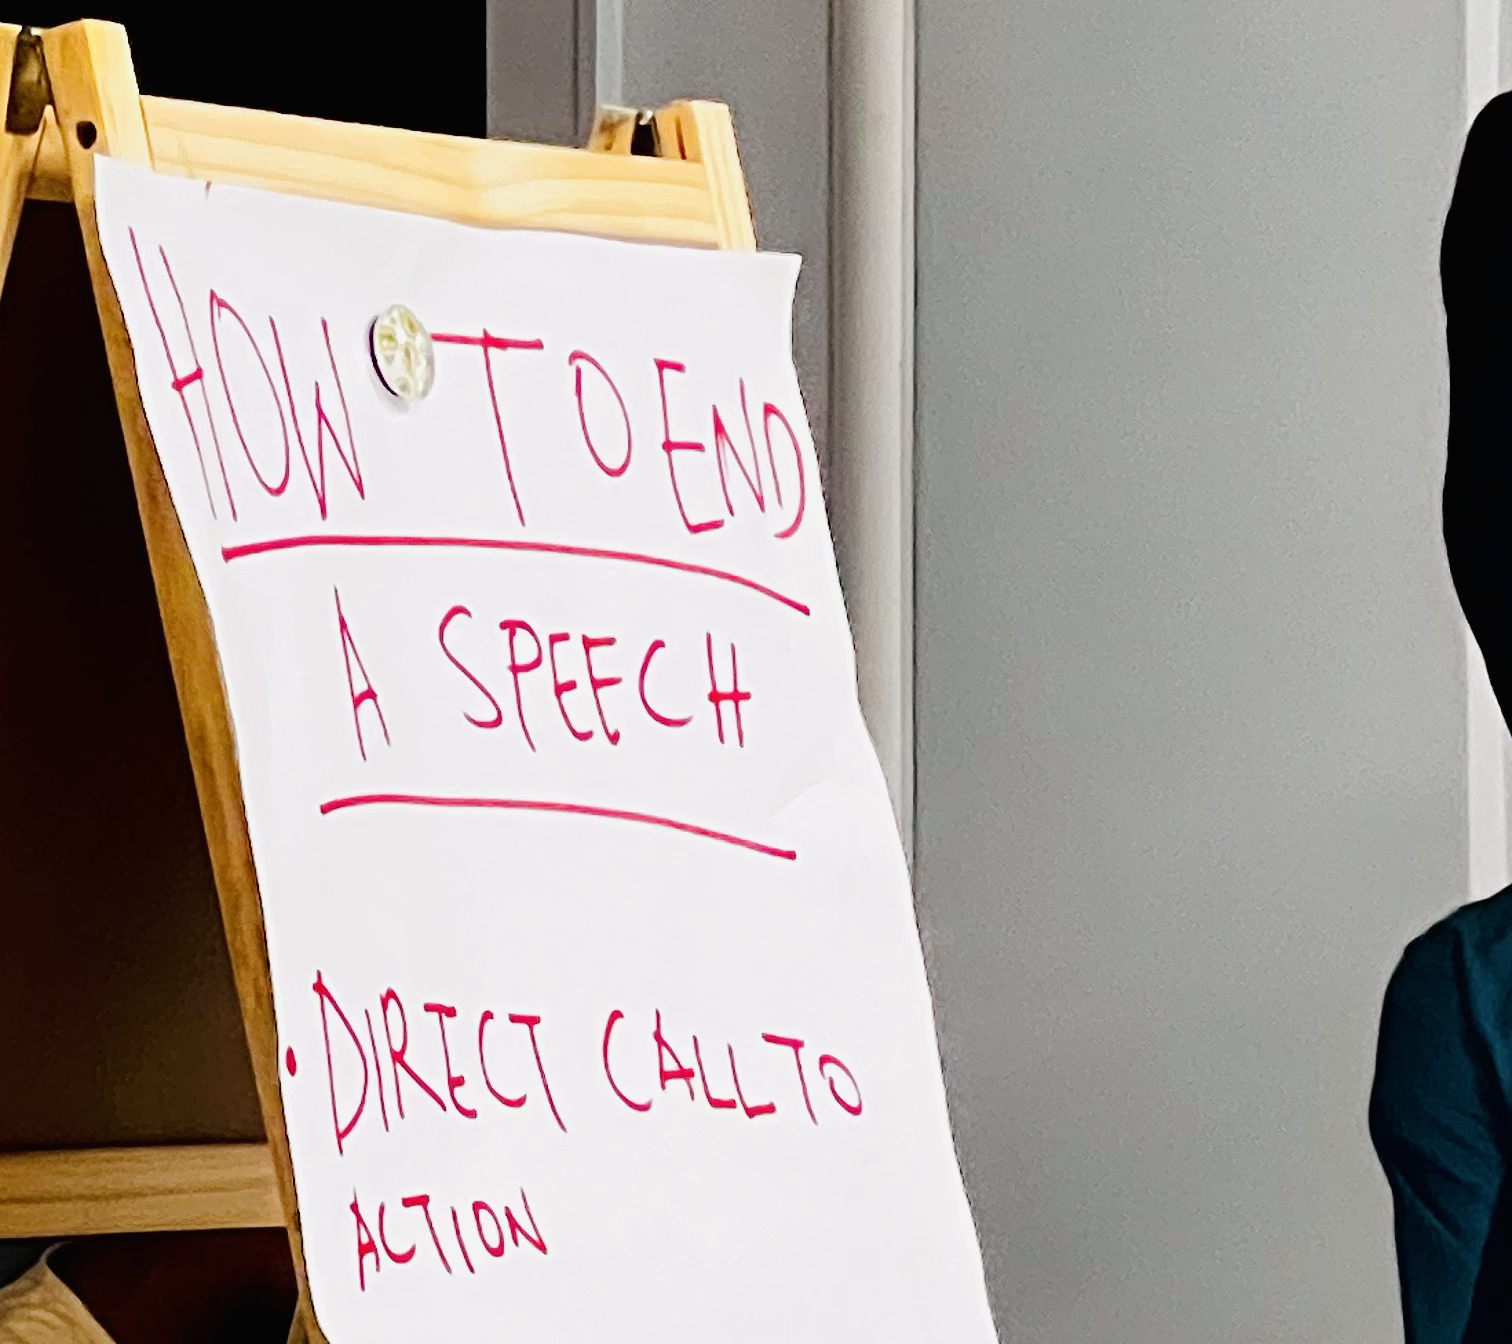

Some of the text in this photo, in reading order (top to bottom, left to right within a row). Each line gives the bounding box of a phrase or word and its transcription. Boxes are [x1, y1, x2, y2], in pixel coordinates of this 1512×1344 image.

[127, 226, 808, 540] HOW TO END
[332, 584, 753, 762] A SPEECH
[312, 969, 864, 1156] DIRECT CALL TO
[350, 1187, 549, 1292] ACTION
